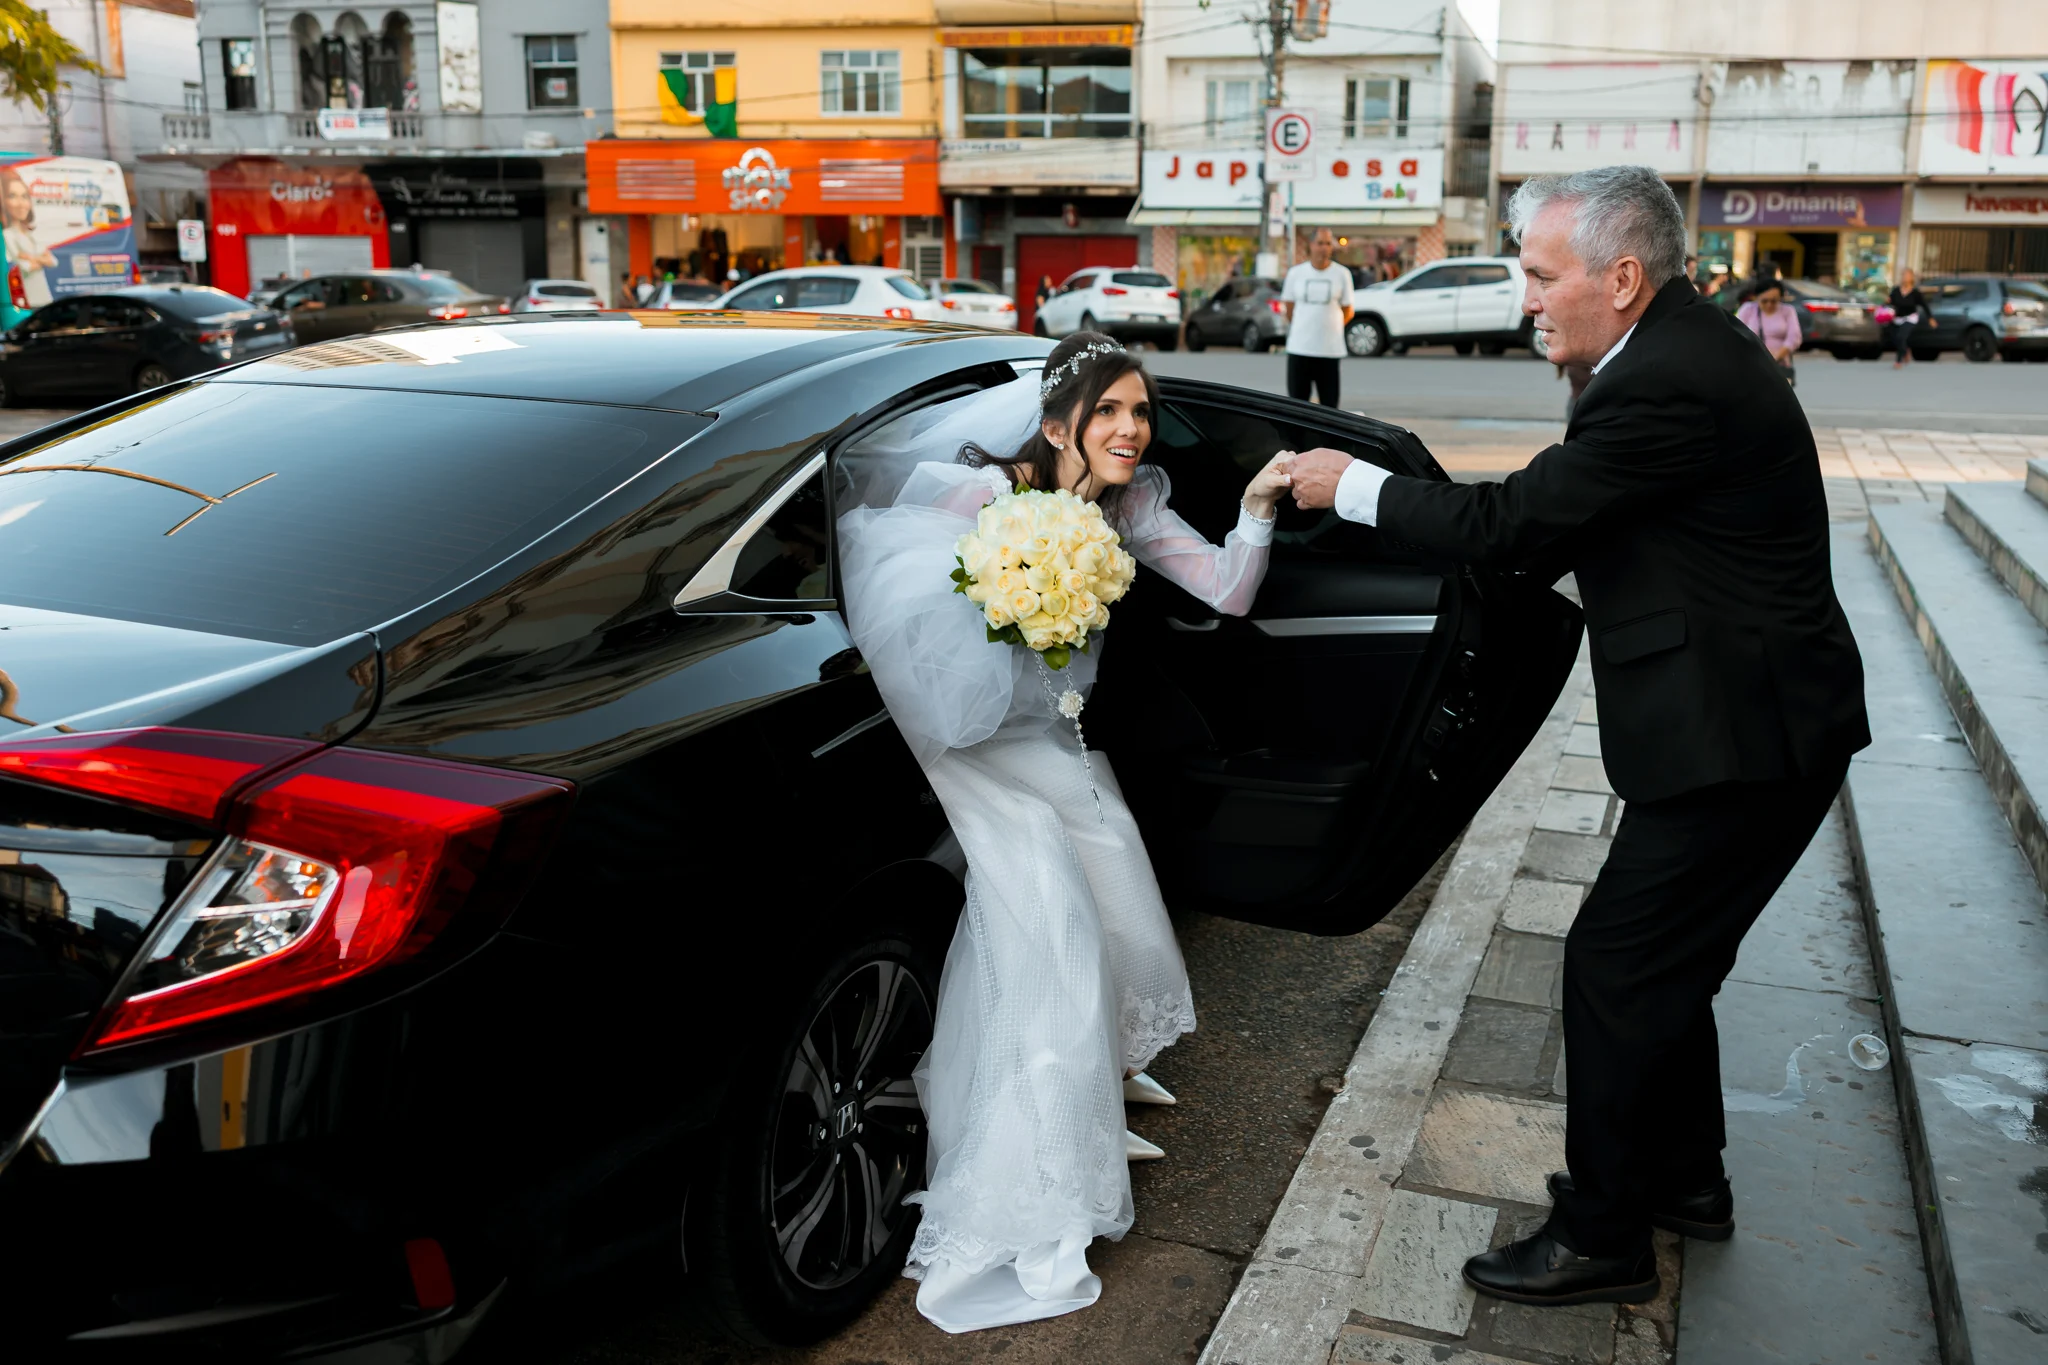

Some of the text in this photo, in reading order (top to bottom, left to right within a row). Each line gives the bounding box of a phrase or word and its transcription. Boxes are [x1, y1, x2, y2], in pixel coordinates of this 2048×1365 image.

[1284, 122, 1299, 147] E
[1165, 155, 1419, 187] Japesa
[270, 179, 326, 201] Claro
[729, 189, 786, 211] SHOP
[1365, 182, 1417, 204] Baby
[1766, 192, 1858, 212] Dmania
